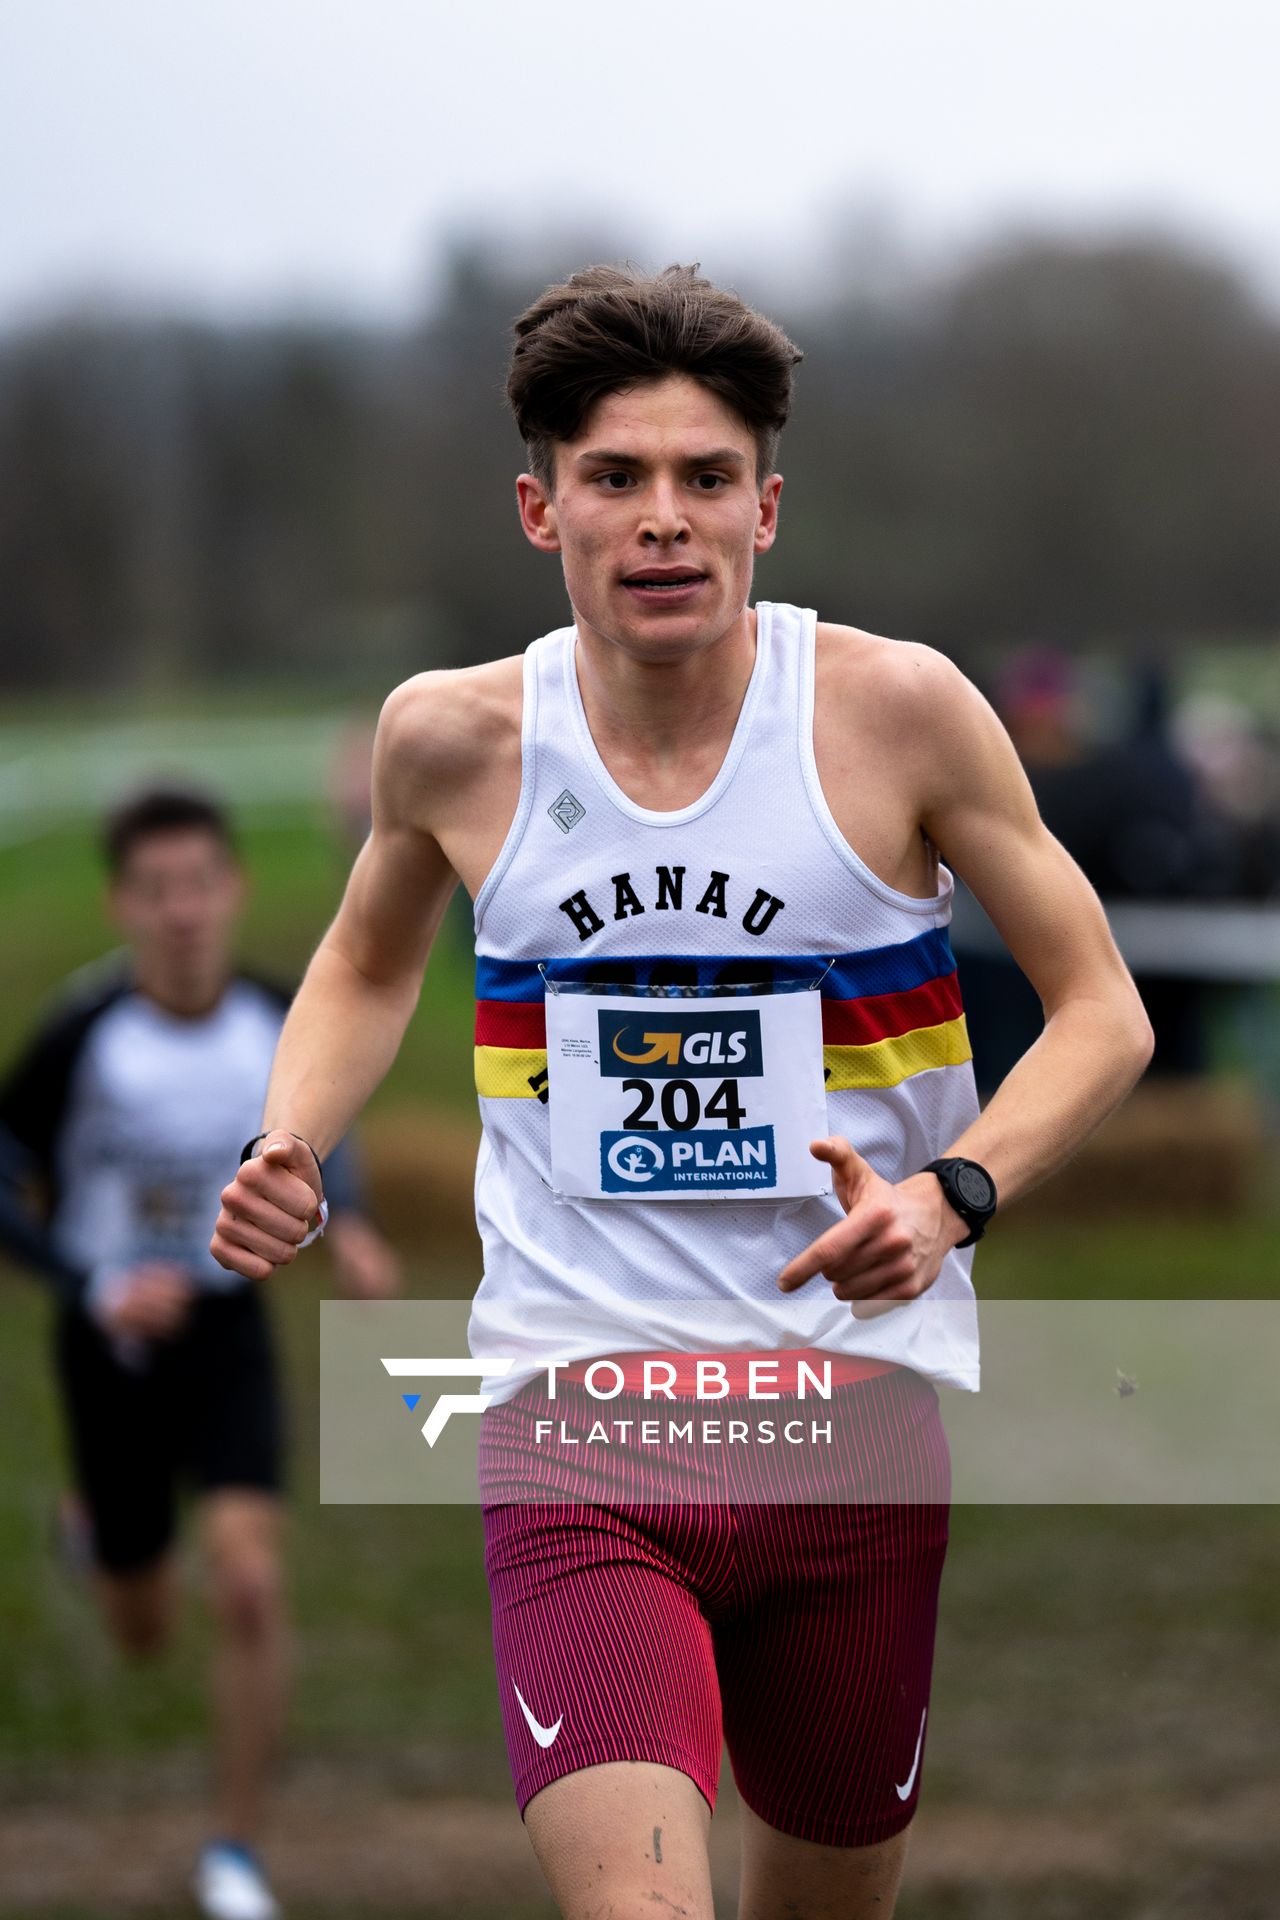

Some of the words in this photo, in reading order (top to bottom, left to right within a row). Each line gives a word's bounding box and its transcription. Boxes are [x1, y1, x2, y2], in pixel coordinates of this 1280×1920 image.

[559, 866, 785, 942] HANAU
[683, 1031, 747, 1064] GLS
[622, 1079, 747, 1131] 204
[671, 1140, 767, 1167] PLAN
[674, 1171, 768, 1181] INTERNATIONAL
